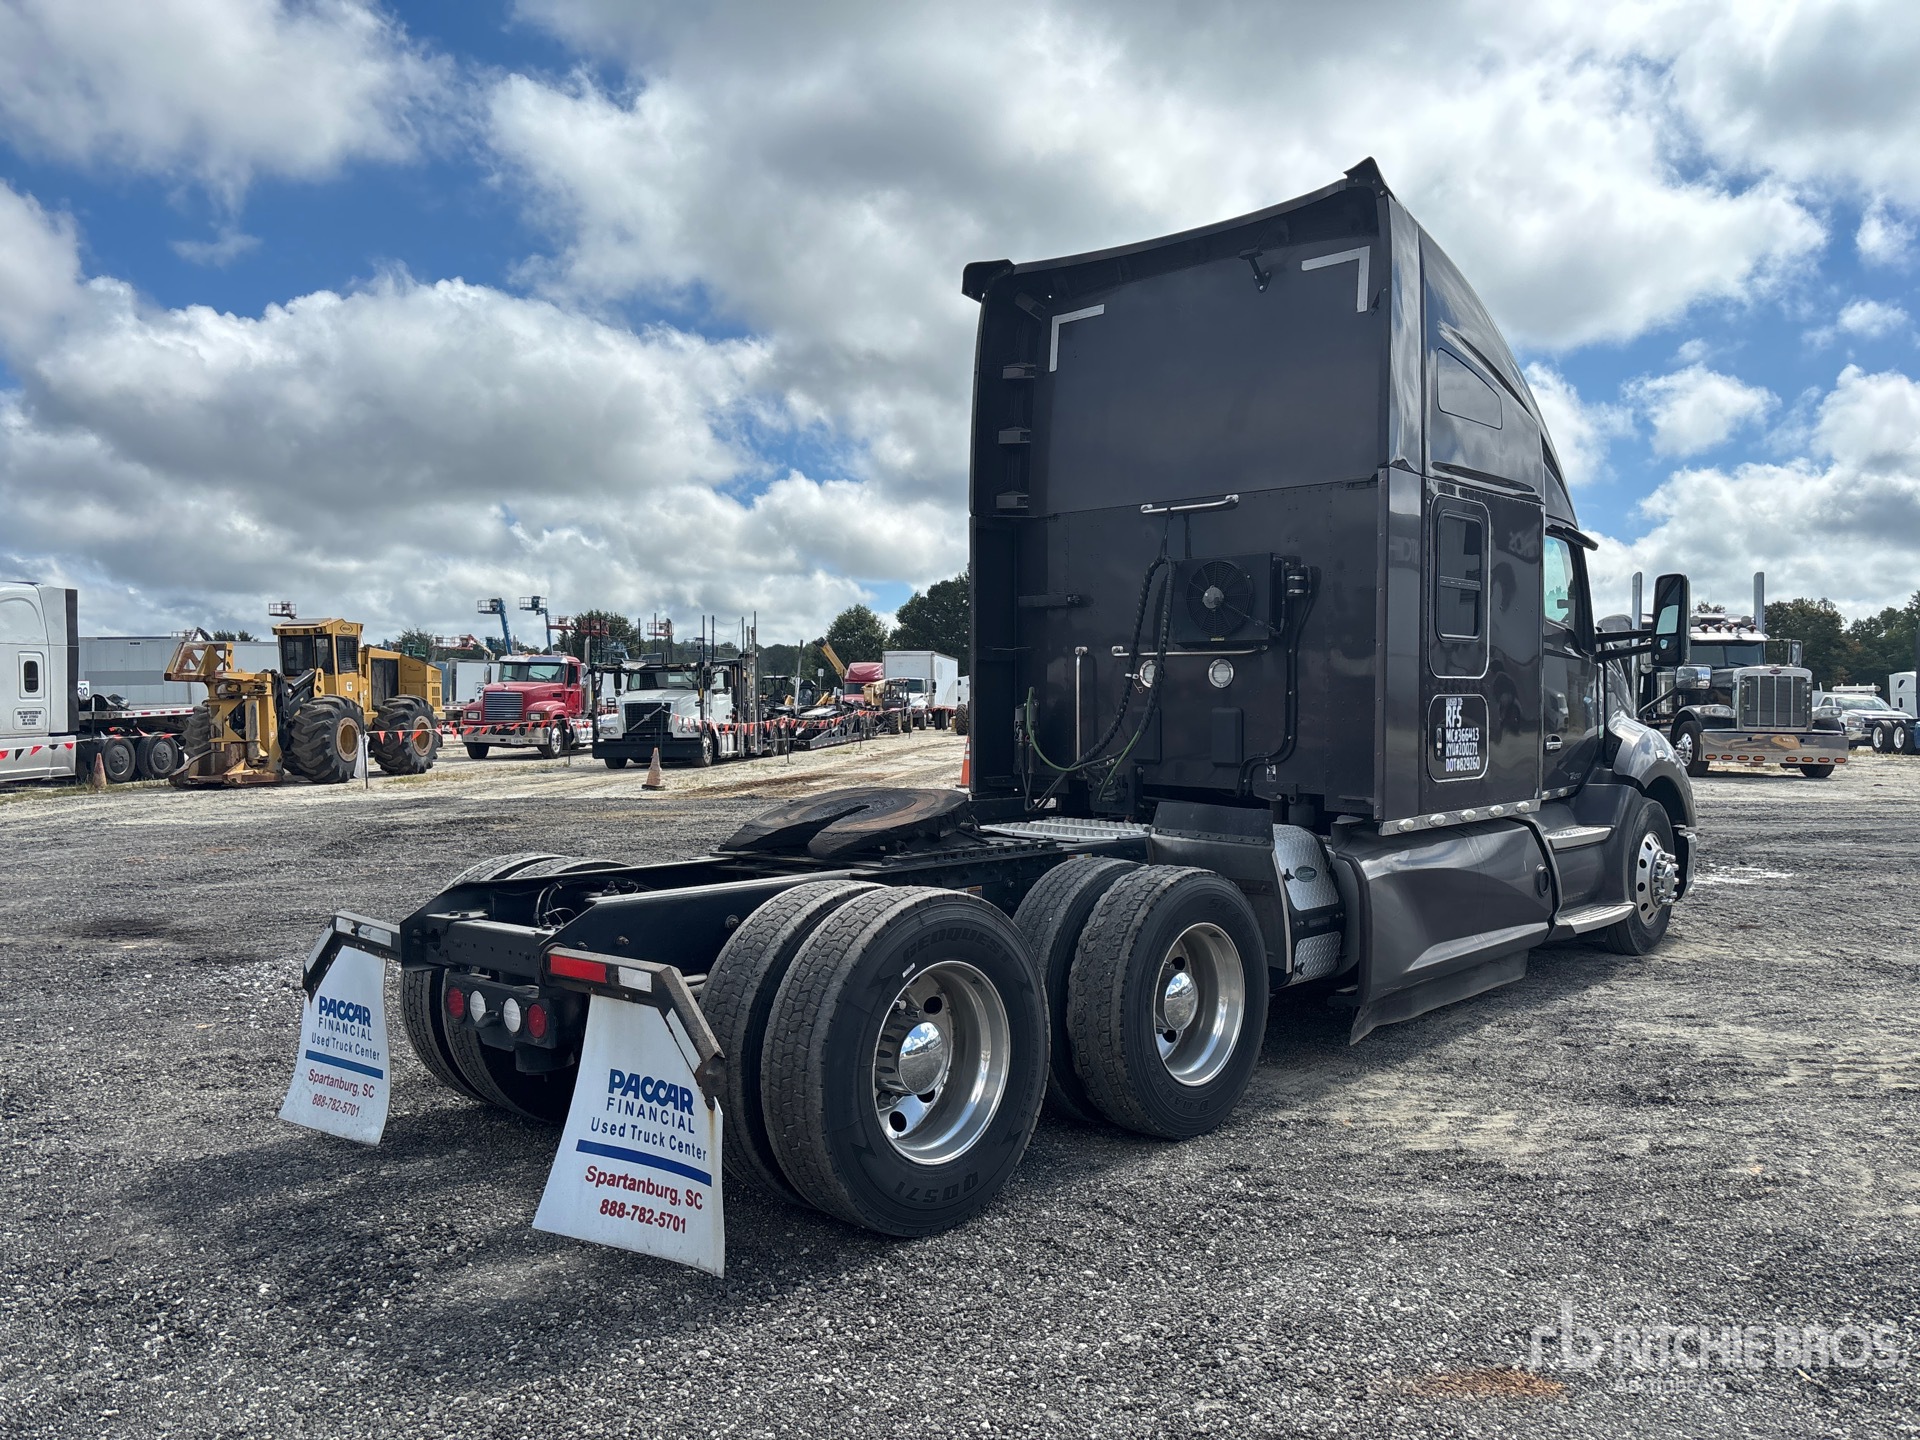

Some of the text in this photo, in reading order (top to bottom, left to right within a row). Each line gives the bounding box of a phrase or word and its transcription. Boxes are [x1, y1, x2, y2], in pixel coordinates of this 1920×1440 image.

[1446, 705, 1462, 728] RFS
[318, 995, 372, 1028] PACCAR
[318, 1017, 373, 1041] FINANCIAL
[311, 1032, 380, 1061] Used Truck Center
[308, 1068, 376, 1099] Spartanburg, SC
[607, 1068, 695, 1116] PACCAR
[312, 1093, 361, 1118] 888-782-5701
[606, 1097, 695, 1134] FINANCIAL
[590, 1116, 707, 1161] Used Truck Center
[585, 1165, 704, 1210] Spartanburg, SC
[599, 1198, 687, 1234] 888-782-5701
